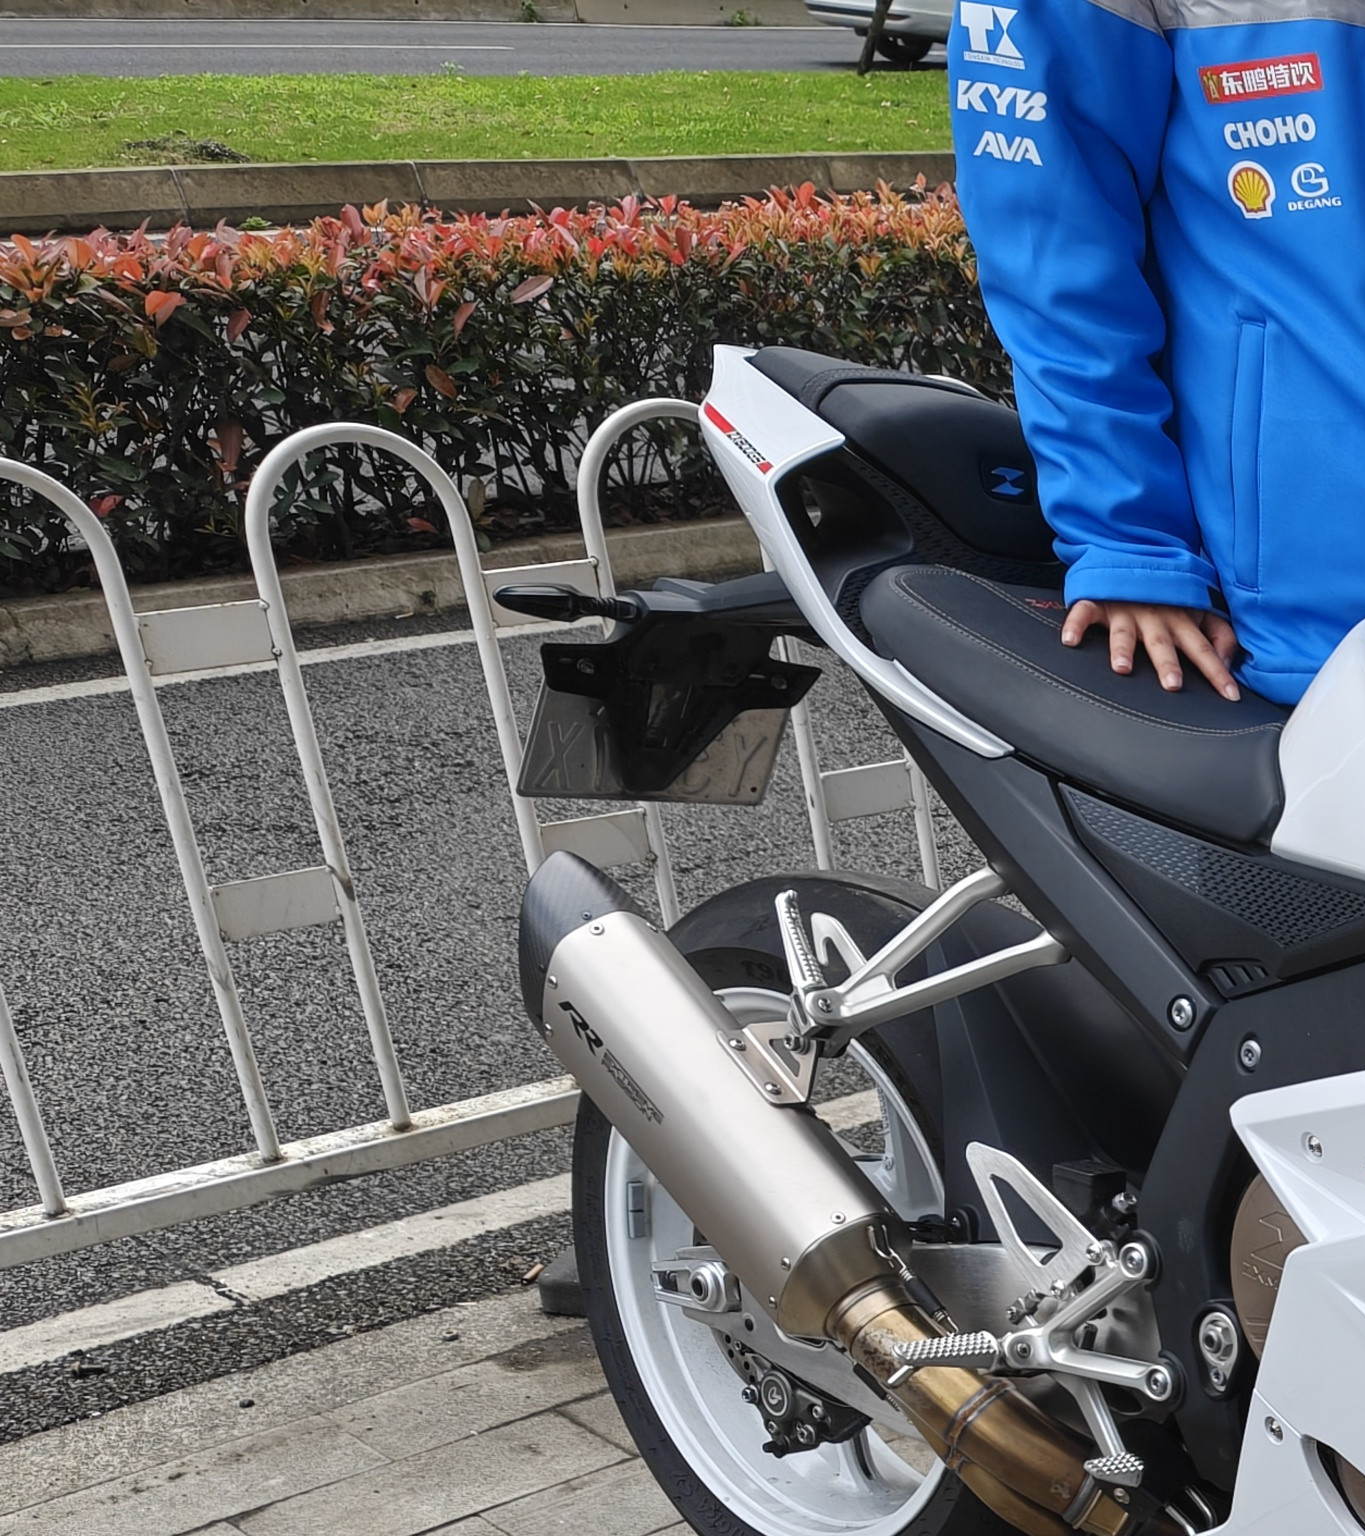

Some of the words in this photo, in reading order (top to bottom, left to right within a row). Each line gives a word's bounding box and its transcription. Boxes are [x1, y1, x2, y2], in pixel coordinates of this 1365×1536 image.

[1219, 61, 1316, 96] 东鹏特饮
[957, 79, 1047, 121] KYB
[973, 131, 1043, 166] AVA
[1223, 113, 1316, 150] CHOHO
[1287, 196, 1342, 212] DEGANG
